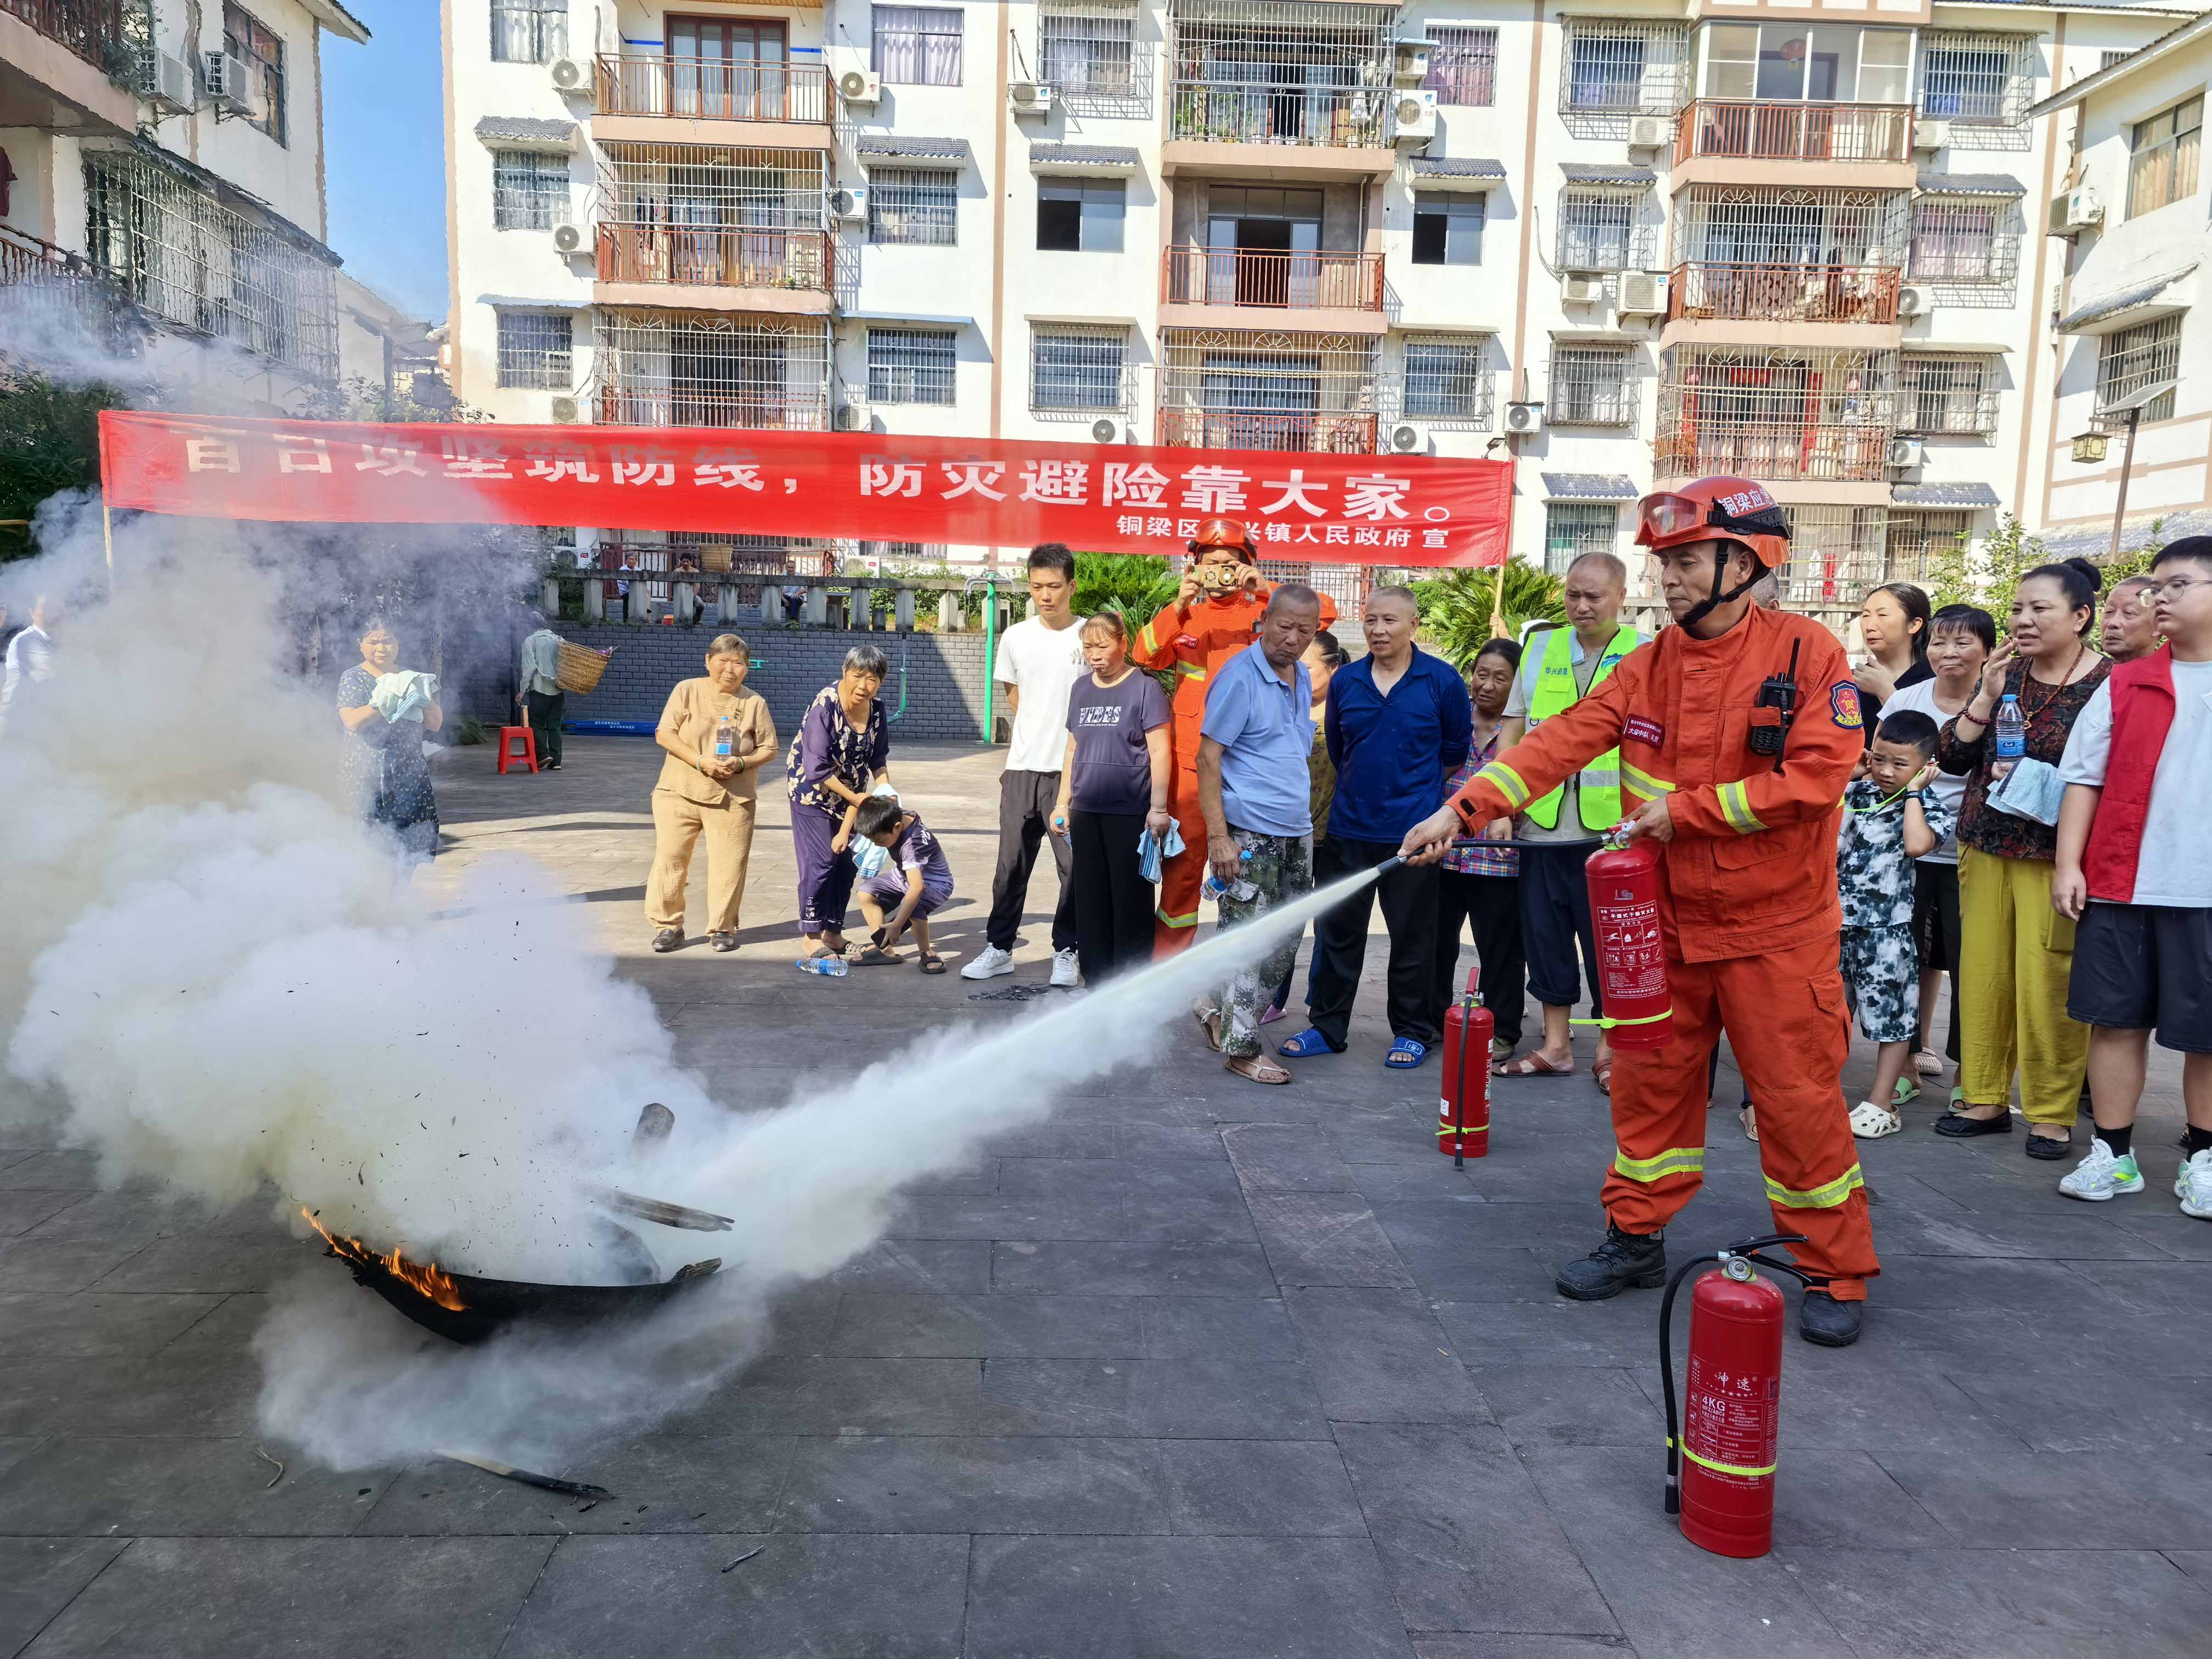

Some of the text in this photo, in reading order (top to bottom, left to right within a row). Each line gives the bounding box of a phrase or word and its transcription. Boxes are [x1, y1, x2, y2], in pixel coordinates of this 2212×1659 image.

[1116, 514, 1449, 548] 铜梁区兴镇人民政府 宣
[1079, 706, 1122, 724] VIBES
[1702, 1396, 1725, 1411] 4KG
